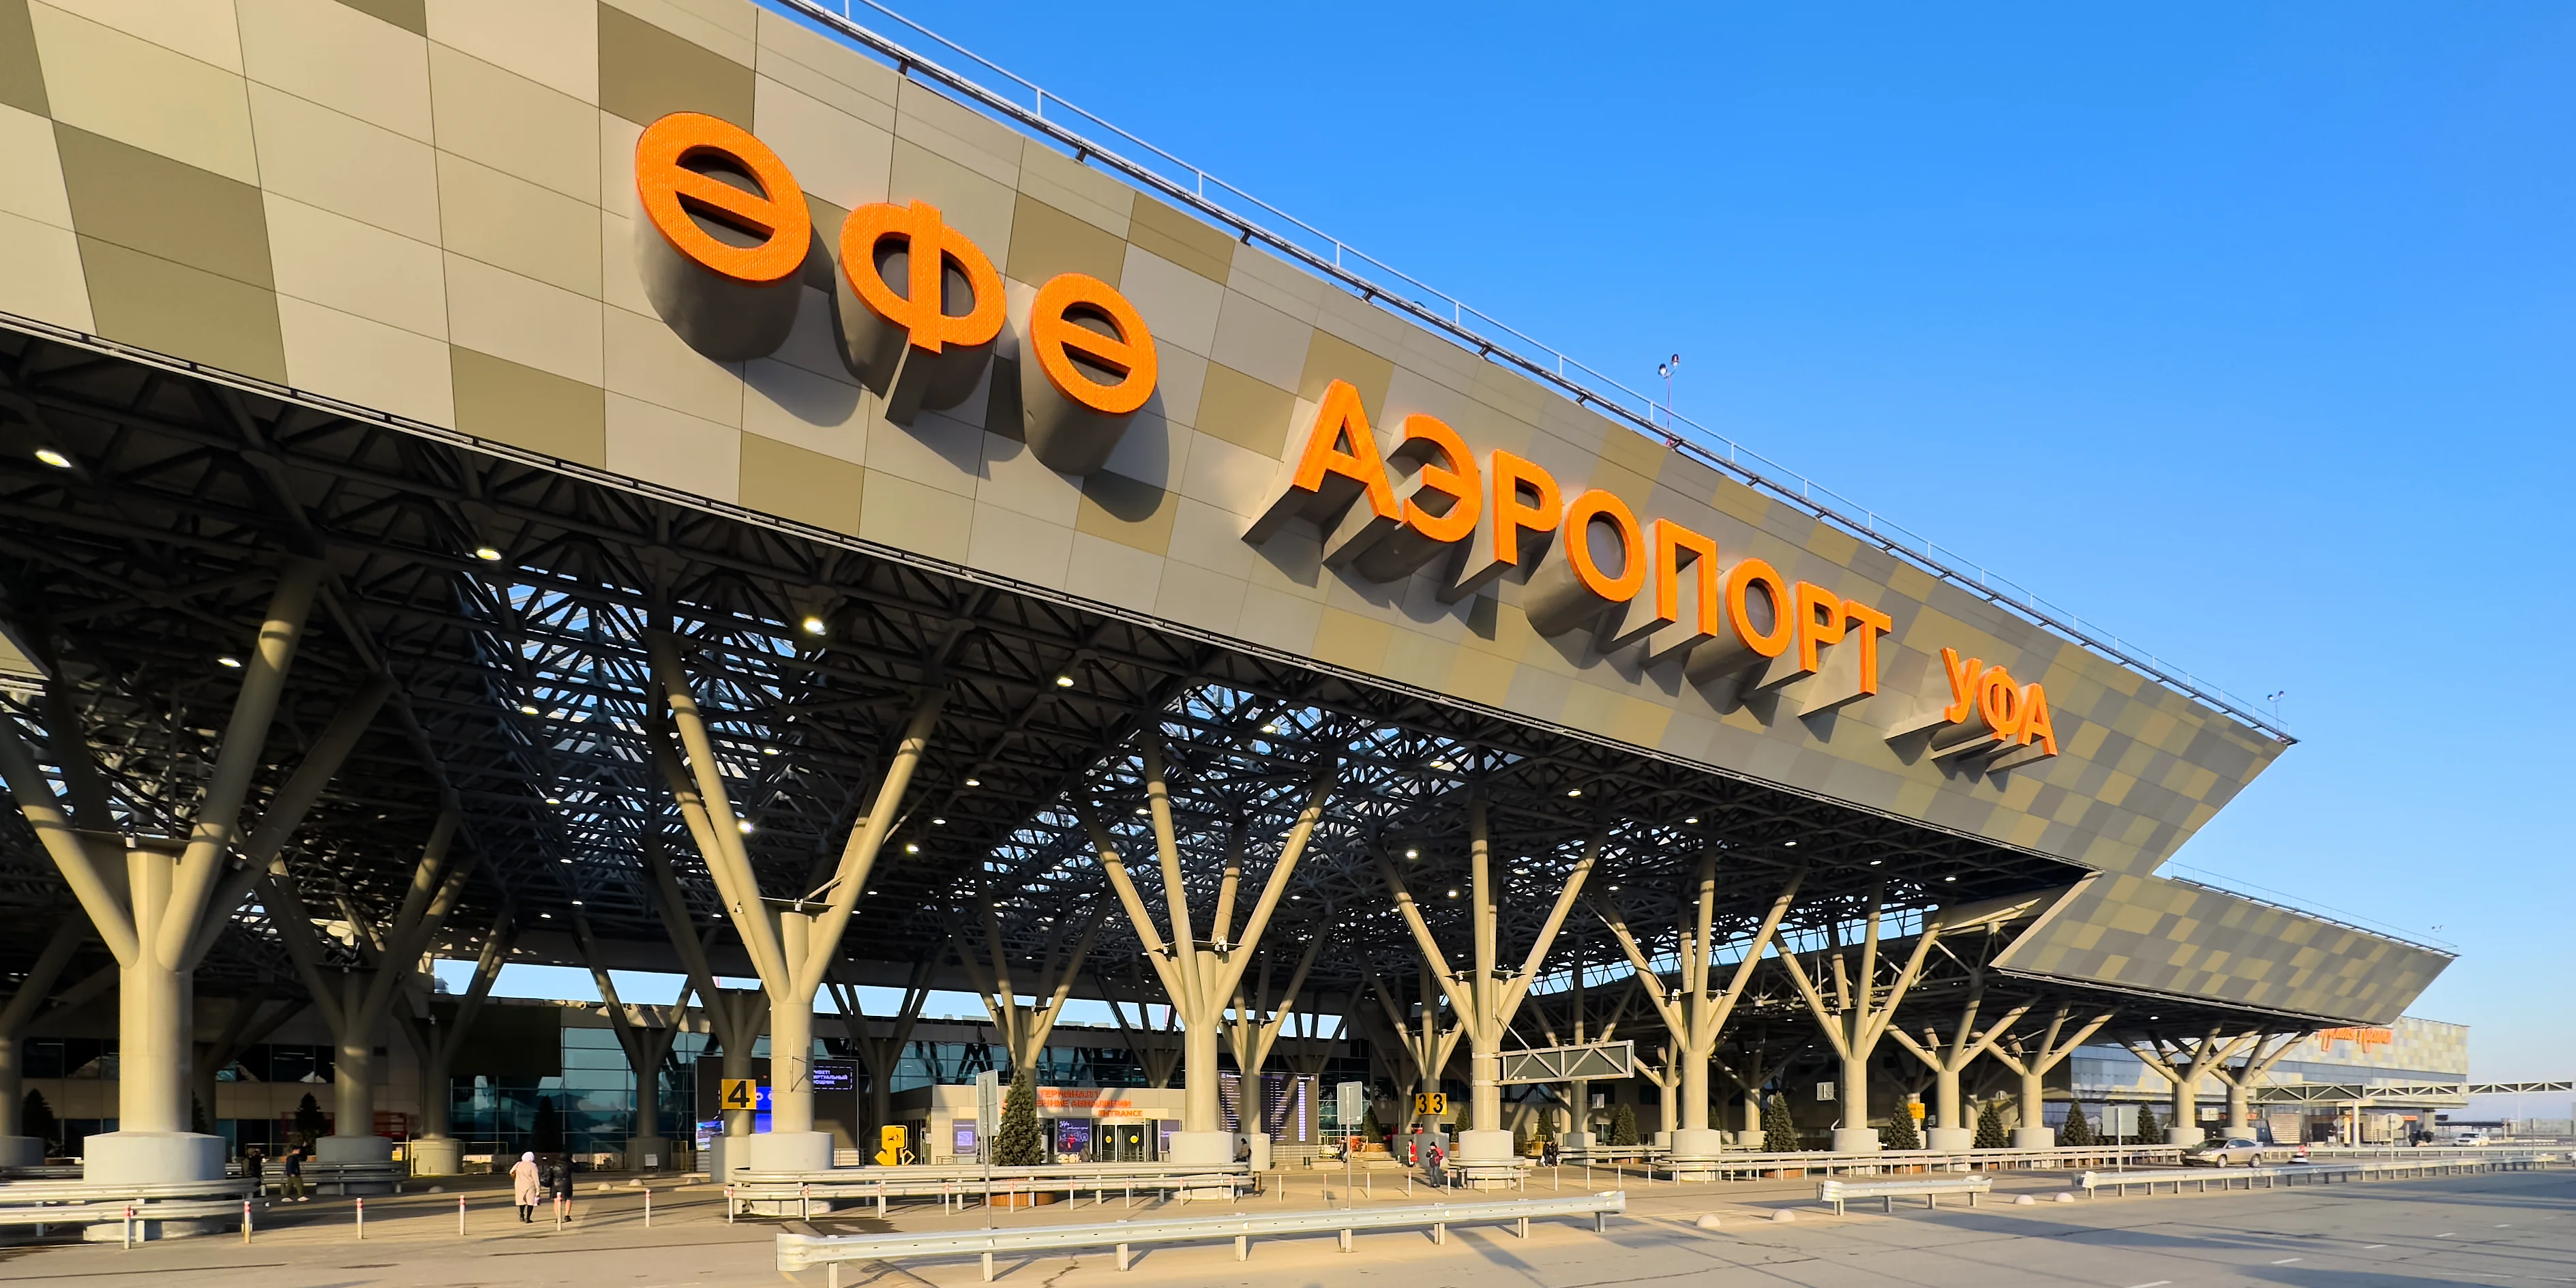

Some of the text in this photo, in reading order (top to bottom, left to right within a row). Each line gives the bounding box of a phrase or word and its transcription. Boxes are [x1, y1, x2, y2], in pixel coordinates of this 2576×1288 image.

[1292, 378, 1893, 696] АЭРОПОРТ
[1940, 646, 2058, 757] УФА
[728, 1080, 750, 1108] 4
[1418, 1094, 1427, 1113] 3
[1433, 1094, 1443, 1113] 3
